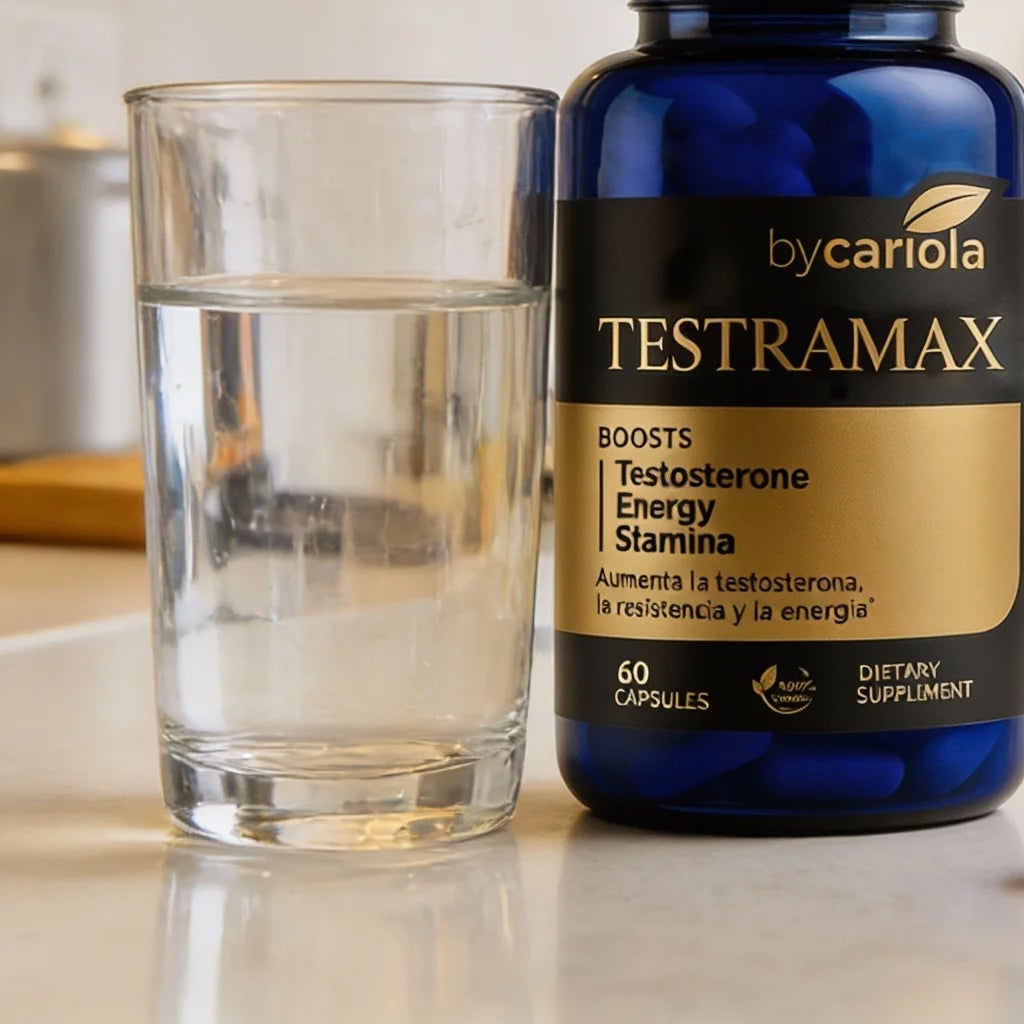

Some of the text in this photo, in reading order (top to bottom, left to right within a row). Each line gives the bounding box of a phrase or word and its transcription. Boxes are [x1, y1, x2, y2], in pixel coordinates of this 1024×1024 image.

[769, 228, 985, 277] bycariola
[599, 316, 1005, 372] TESTRAMAX
[598, 426, 693, 449] BOOSTS
[615, 460, 810, 489] Testosterone
[616, 492, 716, 527] Energy
[615, 525, 735, 555] Stamina
[596, 567, 863, 593] Aumenta la testosterona,
[597, 593, 611, 614] la
[732, 604, 746, 626] y
[754, 600, 772, 621] la
[617, 660, 650, 685] 60
[859, 660, 941, 682] DIETARY
[614, 688, 710, 710] CAPSULES
